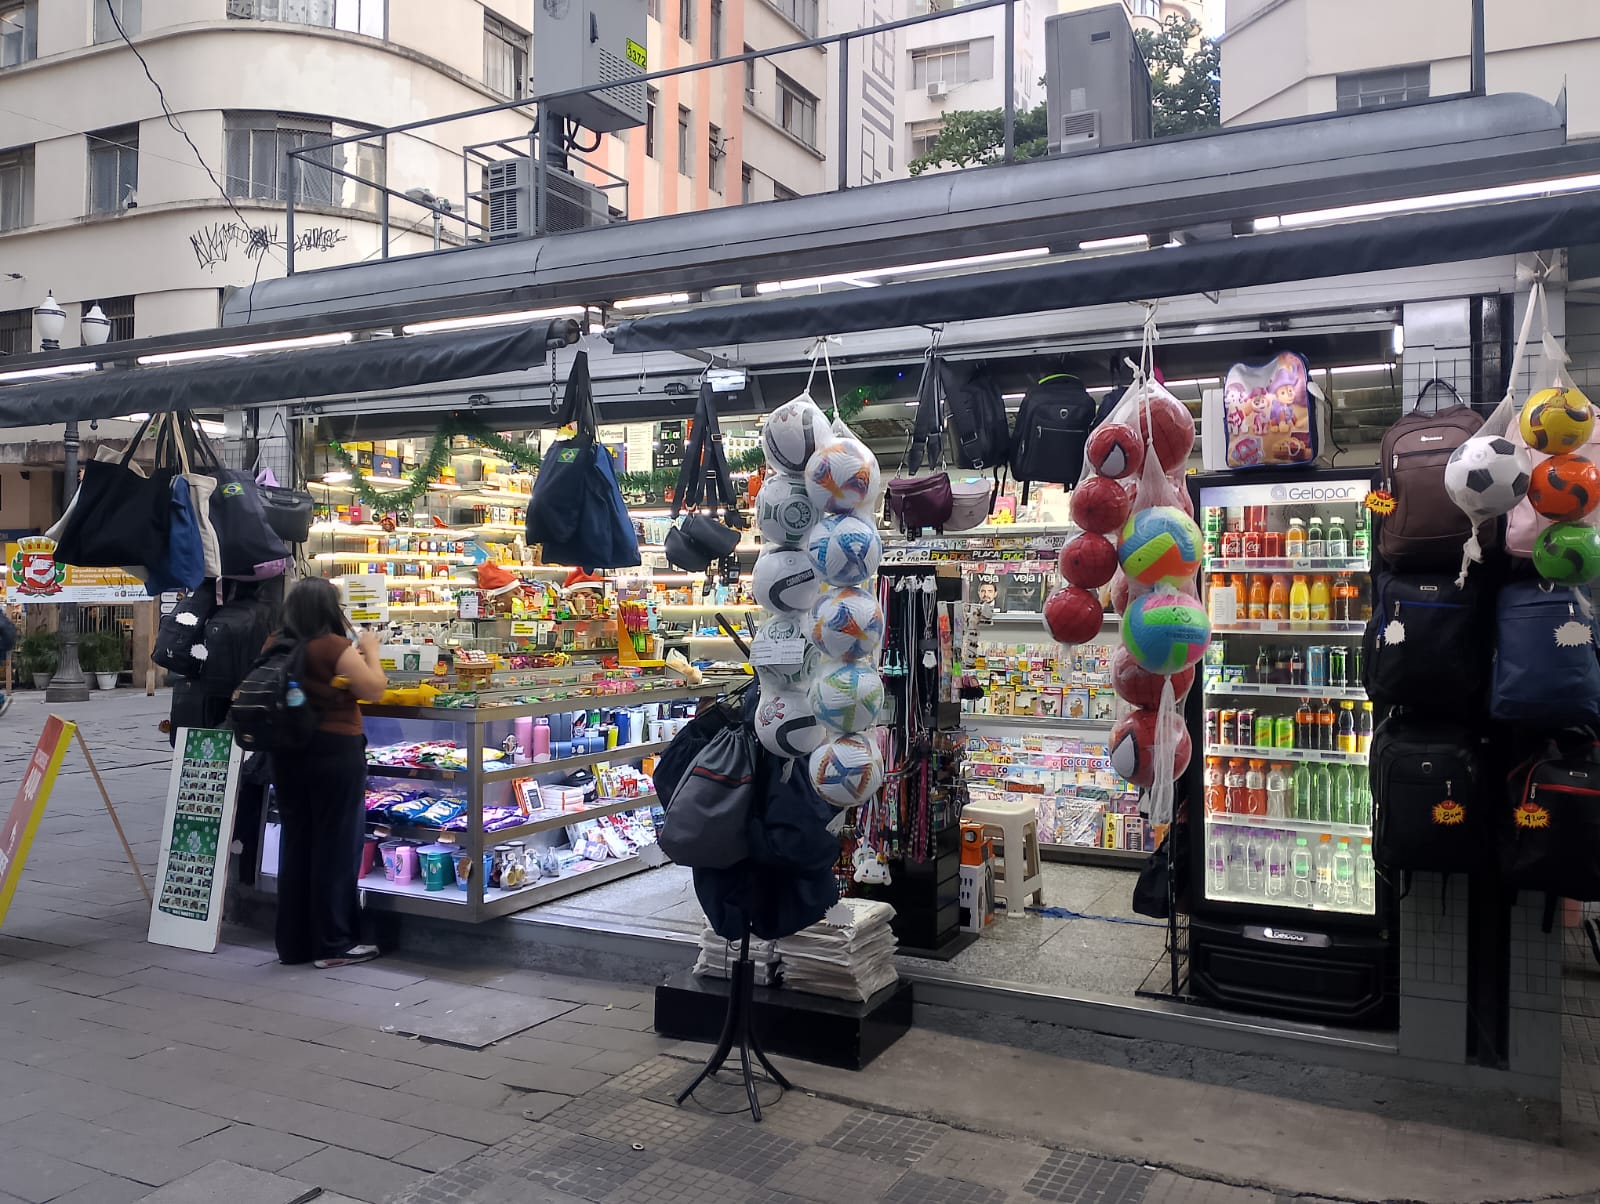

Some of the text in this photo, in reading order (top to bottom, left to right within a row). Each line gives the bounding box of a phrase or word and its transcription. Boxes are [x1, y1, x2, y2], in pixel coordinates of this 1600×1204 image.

[627, 47, 646, 67] 3372
[1289, 487, 1356, 502] Gelopar
[977, 574, 999, 584] veja
[1013, 573, 1036, 584] veja
